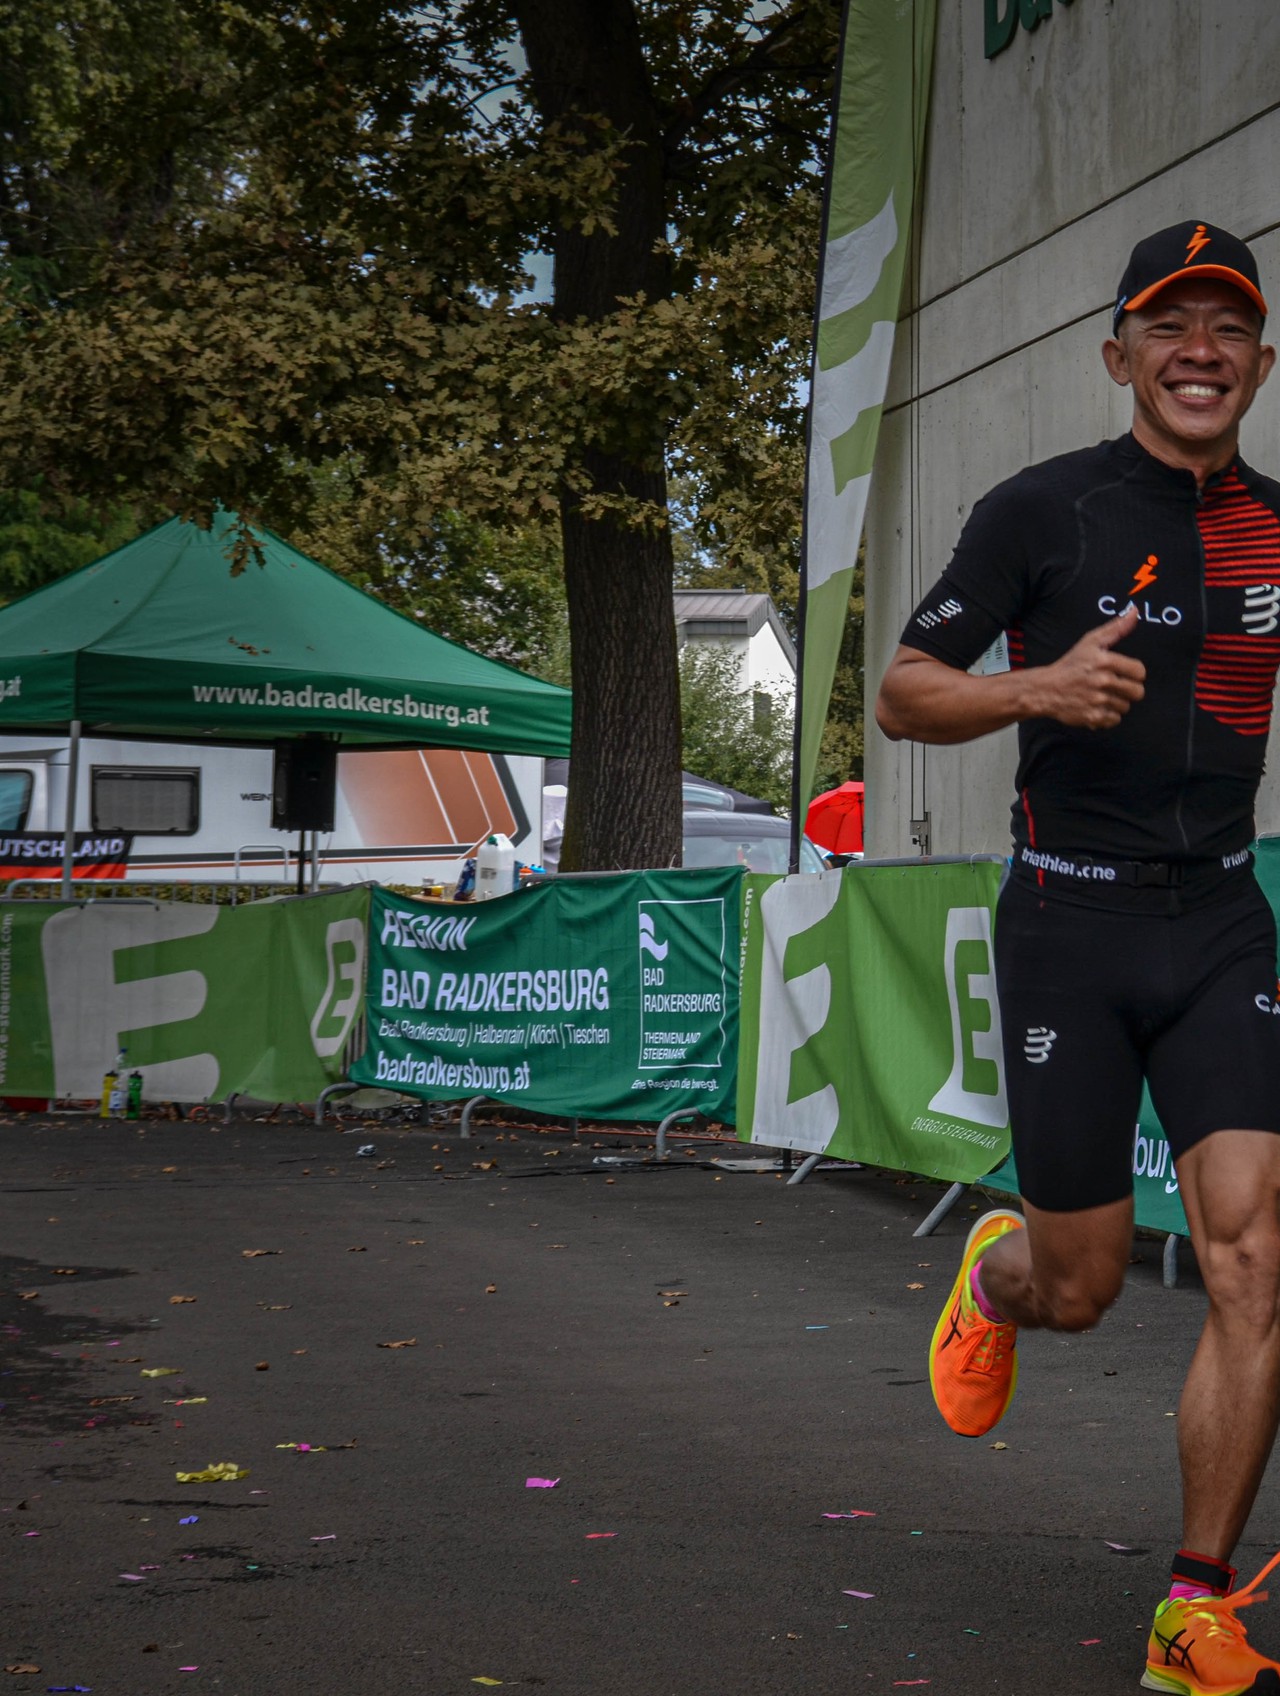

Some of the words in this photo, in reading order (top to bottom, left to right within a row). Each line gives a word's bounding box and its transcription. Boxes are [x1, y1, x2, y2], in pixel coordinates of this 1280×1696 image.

[192, 683, 490, 727] www.badradkersburg.at
[0, 838, 125, 859] UTSCHAND
[380, 908, 478, 951] REGION
[381, 968, 431, 1010] BAD
[434, 967, 610, 1012] RADKERSBURG
[643, 967, 665, 987] BAD
[644, 993, 721, 1013] RADKERSBURG
[400, 1019, 468, 1048] Radkersburg
[473, 1024, 525, 1045] Halbenrain
[530, 1022, 560, 1045] Klöch
[564, 1022, 610, 1045] Tieschen
[644, 1031, 702, 1045] THERMENLAND
[642, 1047, 688, 1061] STEIERMARK
[374, 1050, 532, 1094] badradkersburg.at
[910, 1116, 948, 1134] ENERGIE
[941, 1123, 1002, 1150] STEIERMARK
